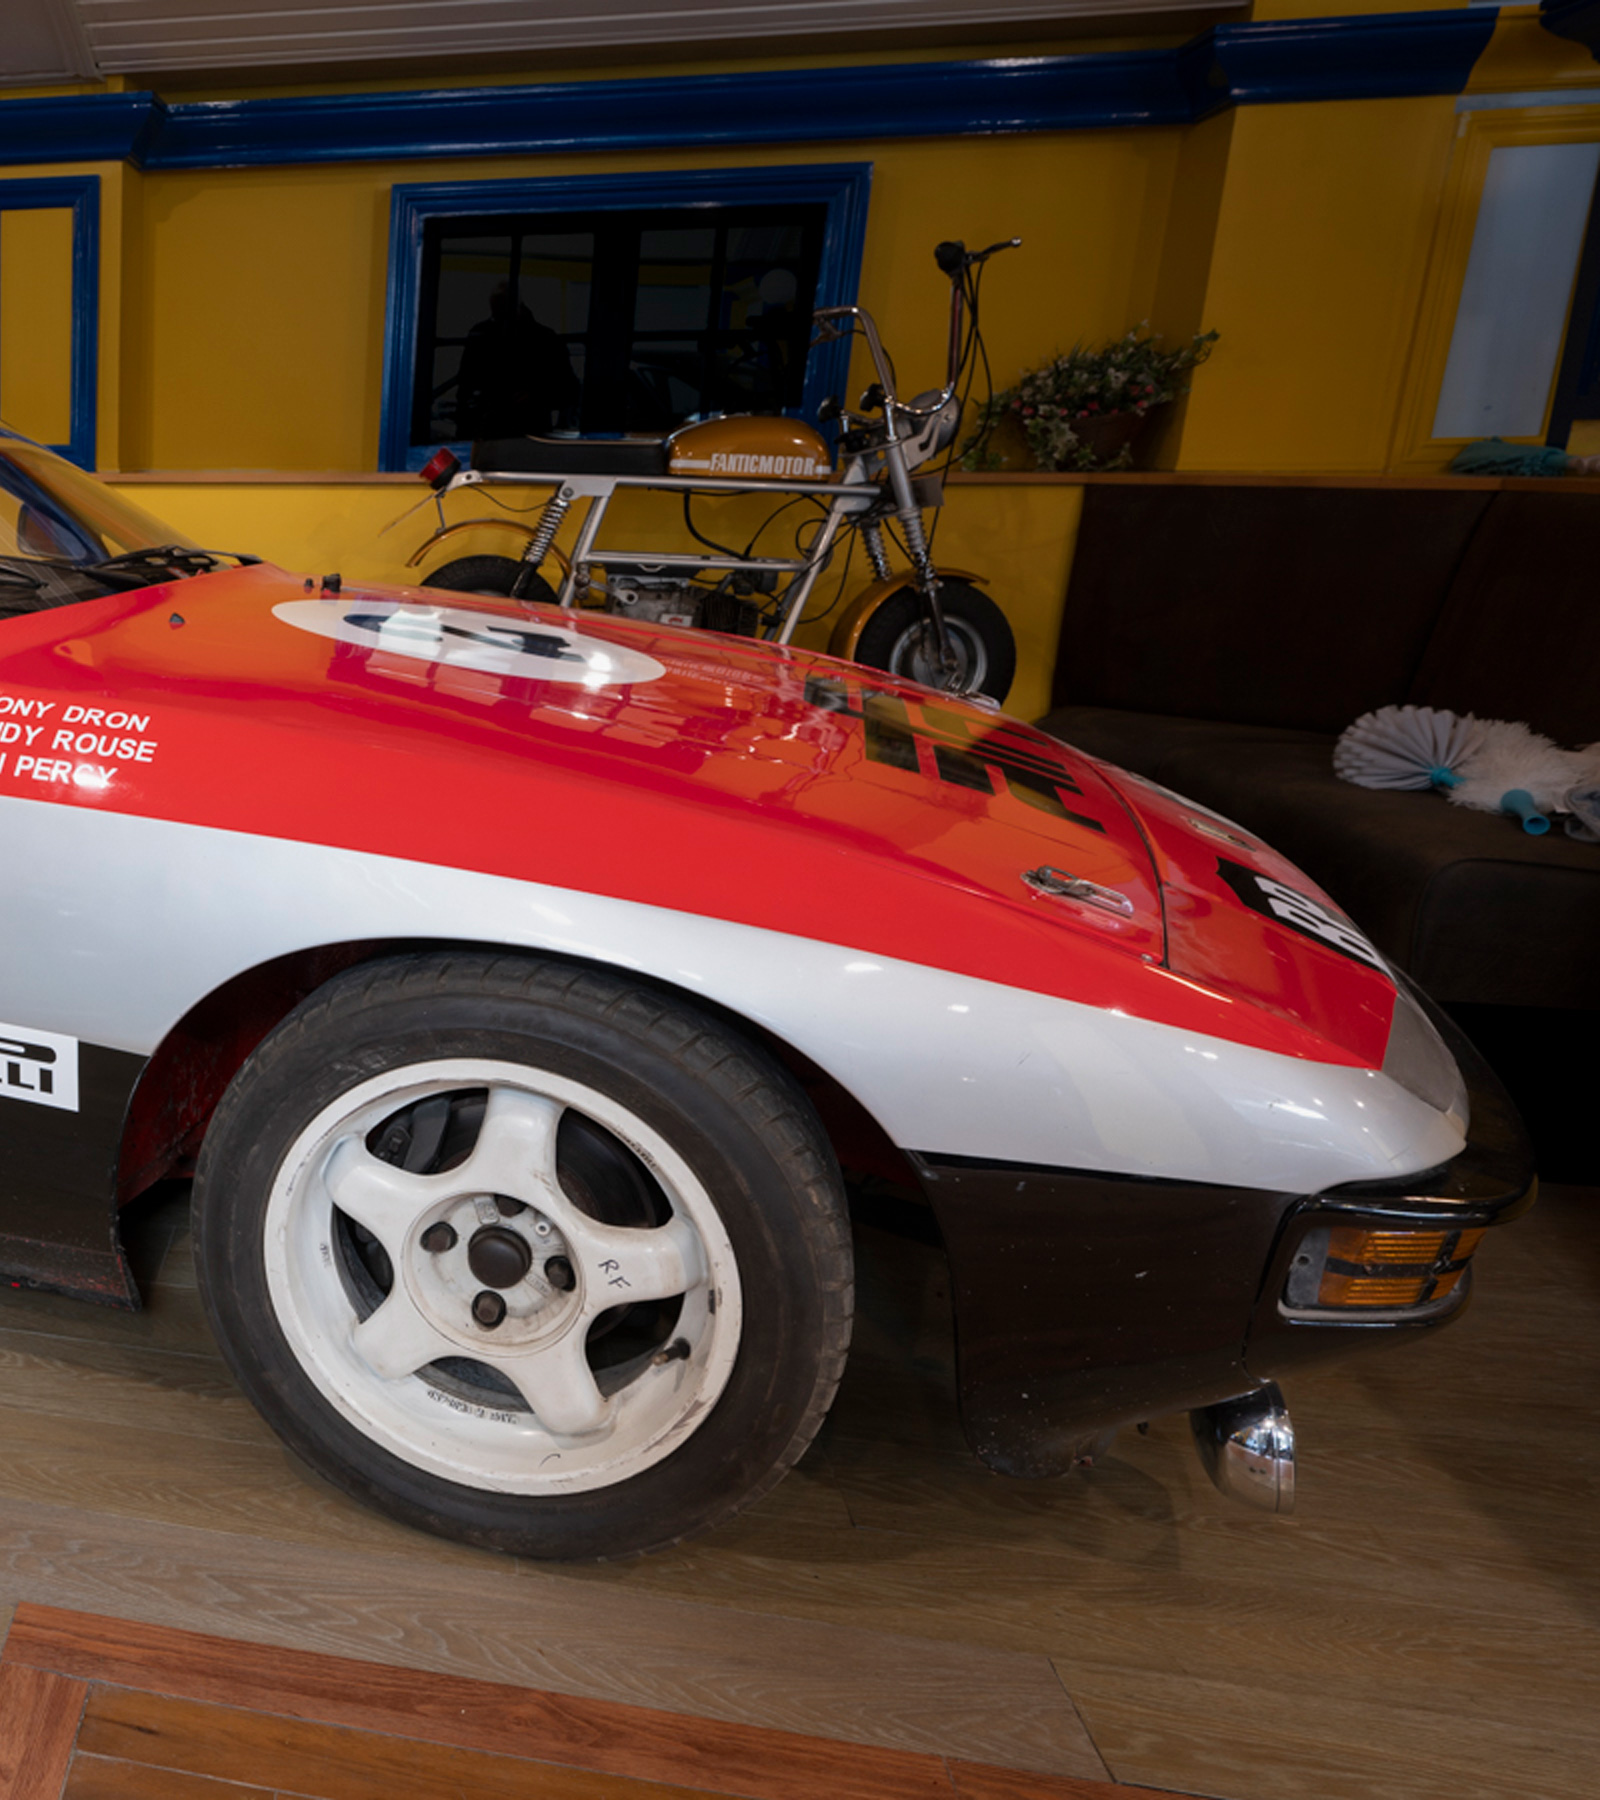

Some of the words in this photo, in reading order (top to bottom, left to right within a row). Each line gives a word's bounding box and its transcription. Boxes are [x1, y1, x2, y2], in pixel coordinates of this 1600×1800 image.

[710, 453, 815, 476] FANTICMOTOR
[62, 705, 150, 732] DRON
[52, 729, 158, 762] ROUSE
[13, 755, 118, 789] PERCY
